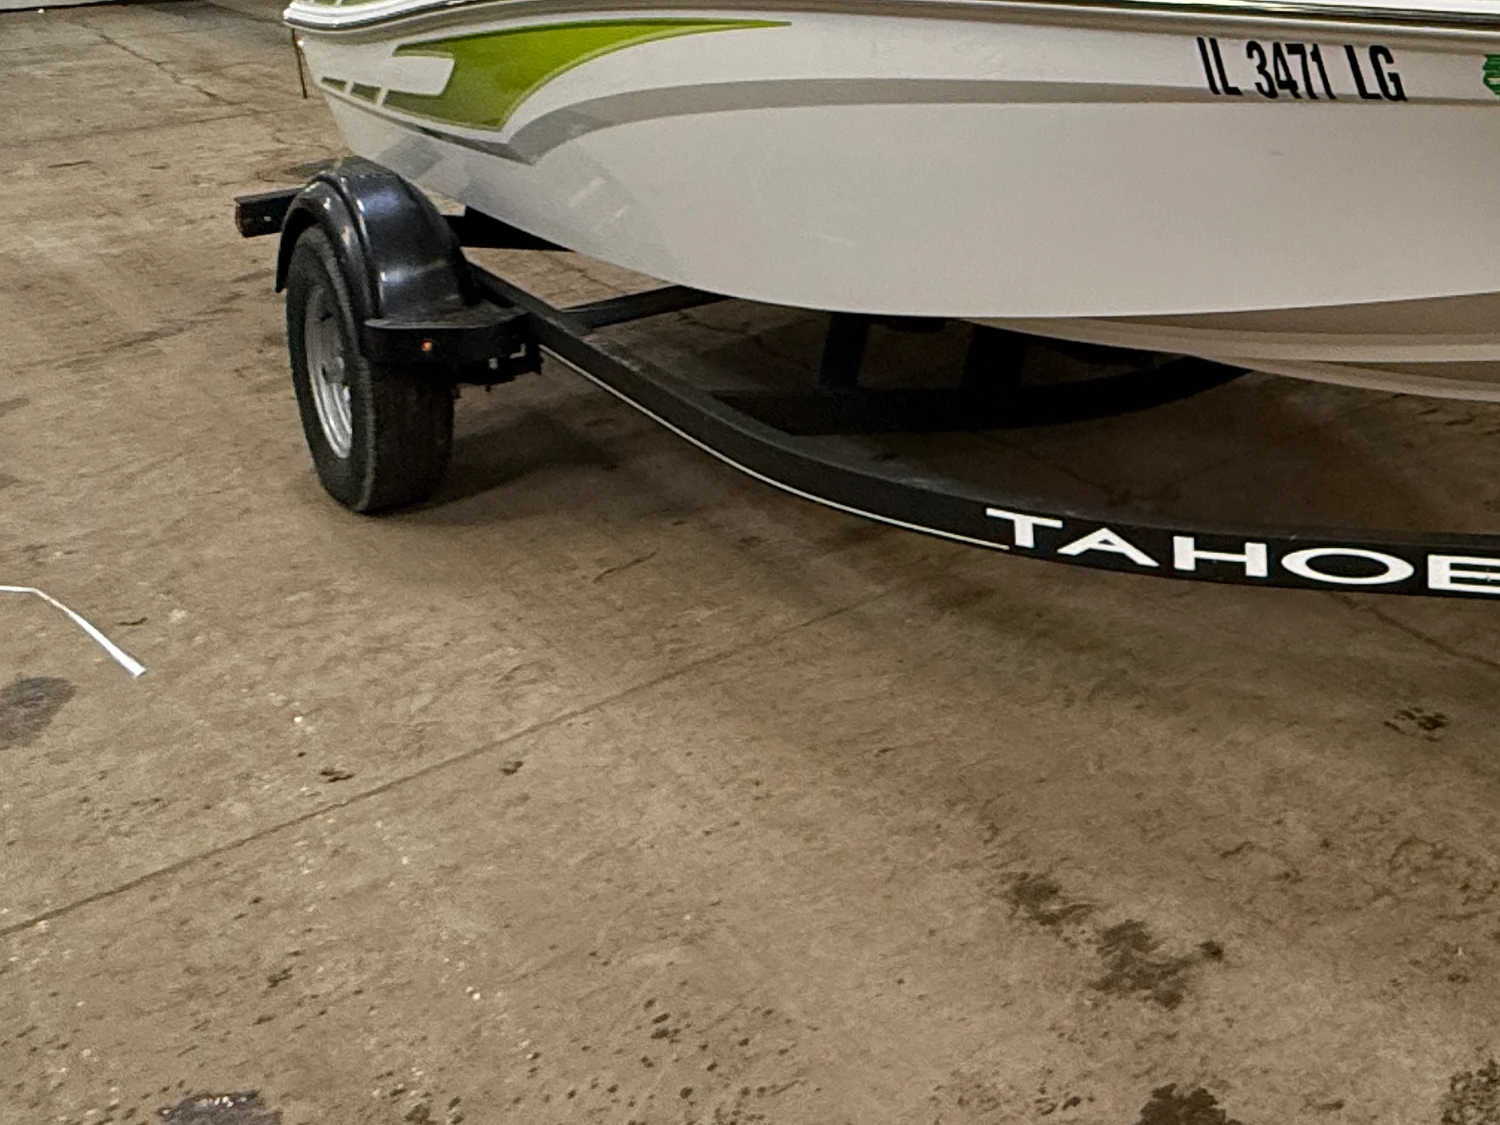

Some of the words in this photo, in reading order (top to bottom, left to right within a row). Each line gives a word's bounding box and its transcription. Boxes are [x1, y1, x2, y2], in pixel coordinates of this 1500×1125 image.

[1196, 36, 1243, 96] IL
[1245, 39, 1337, 100] 3471
[1343, 44, 1409, 102] LG
